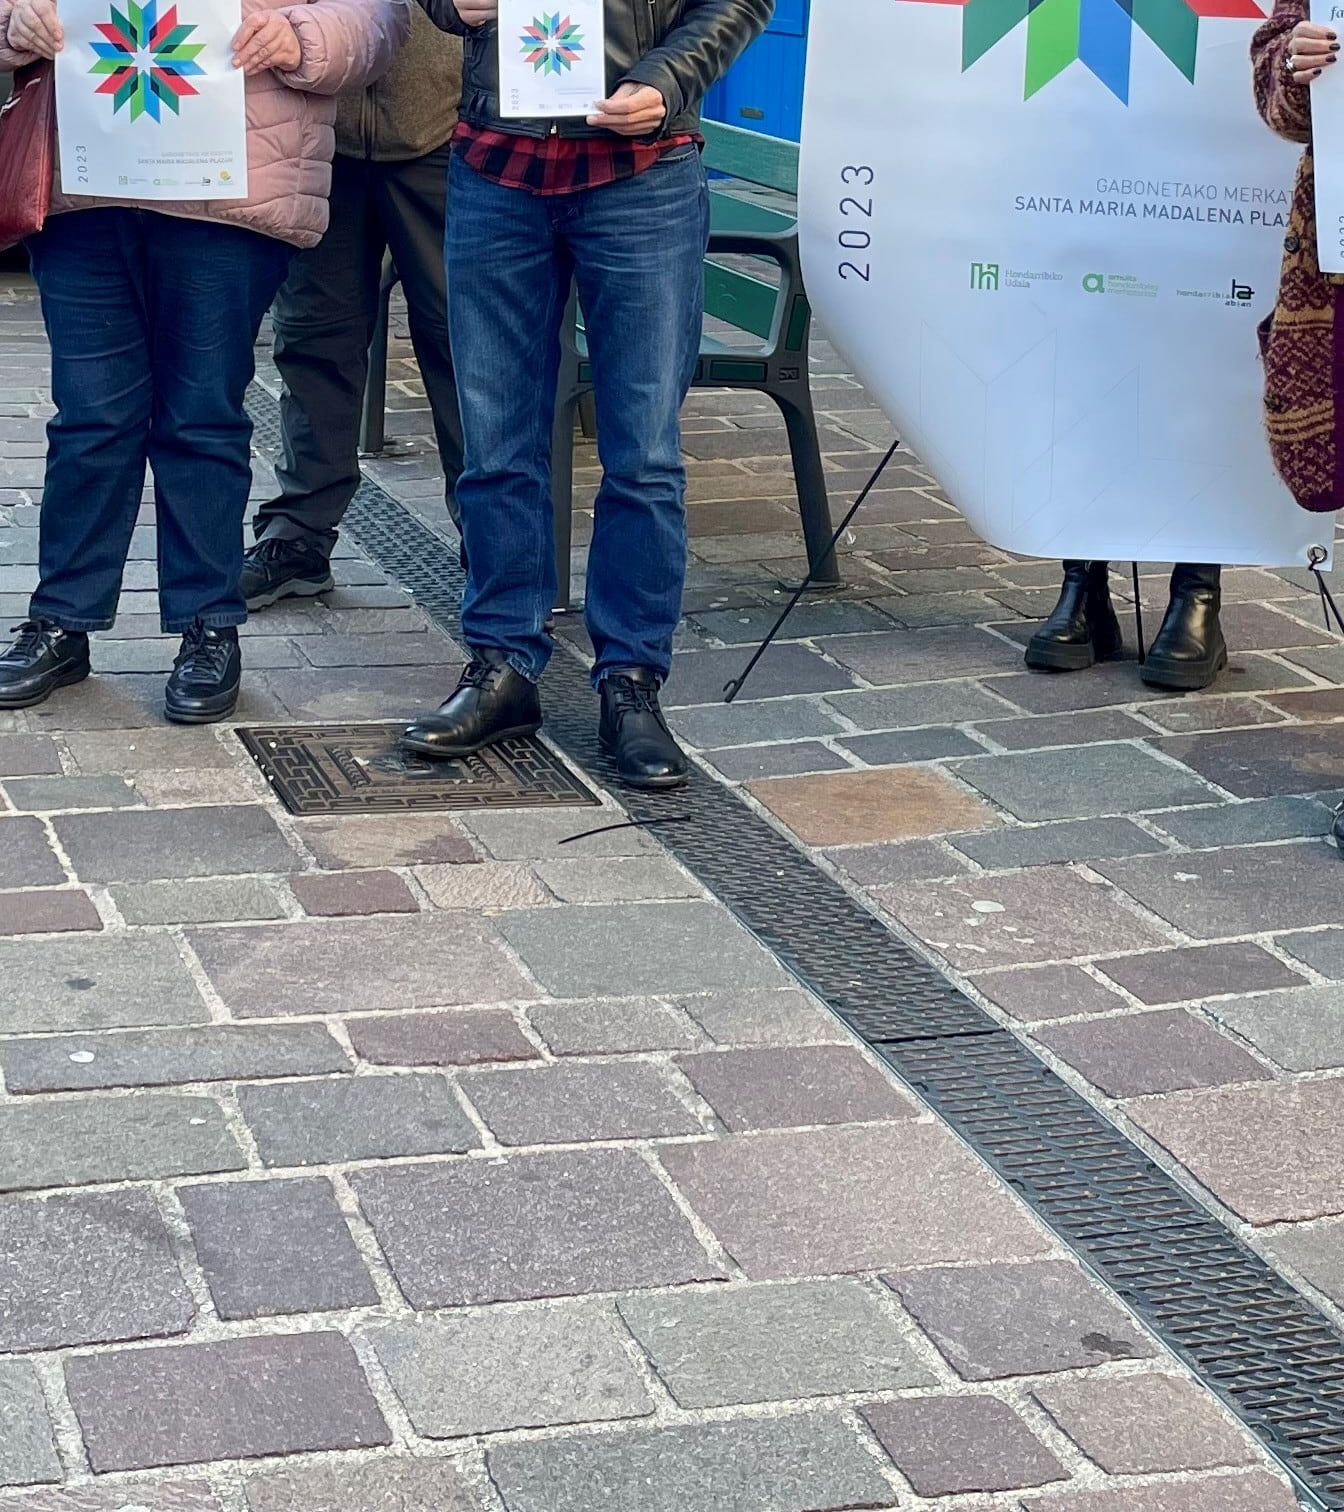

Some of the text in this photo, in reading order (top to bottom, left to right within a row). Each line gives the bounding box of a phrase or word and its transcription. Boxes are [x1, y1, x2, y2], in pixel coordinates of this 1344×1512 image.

[76, 144, 89, 183] 2023
[1096, 178, 1217, 200] GABONETAKO
[838, 165, 874, 282] 2023
[1015, 195, 1074, 214] SANTA
[1079, 199, 1137, 218] MARIA
[1143, 202, 1245, 225] MADALENA
